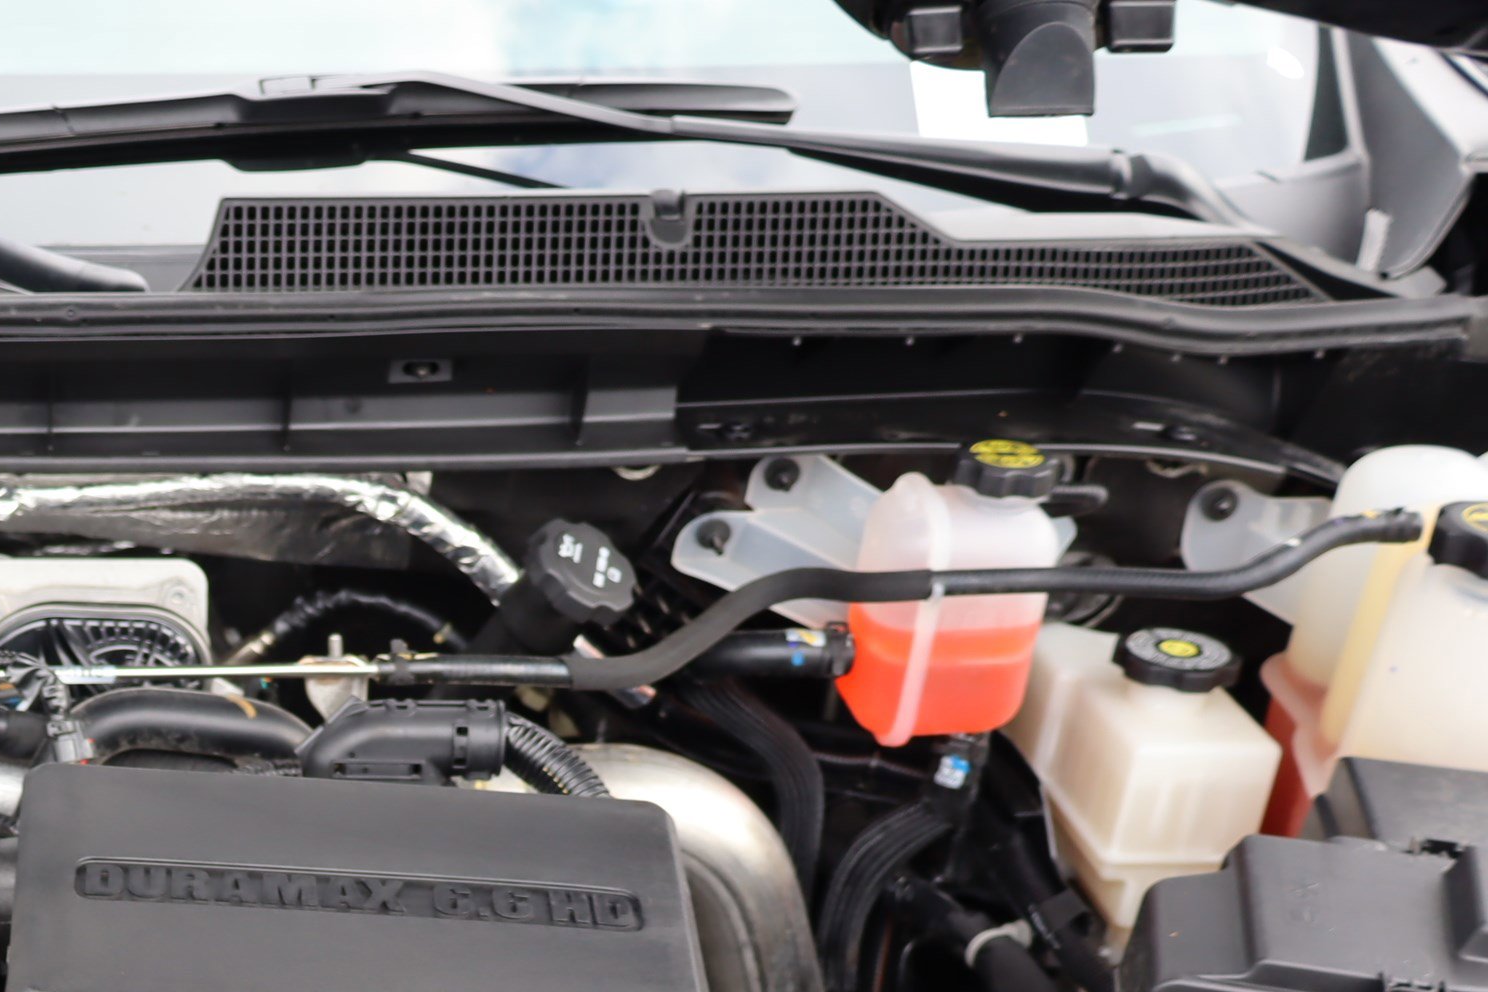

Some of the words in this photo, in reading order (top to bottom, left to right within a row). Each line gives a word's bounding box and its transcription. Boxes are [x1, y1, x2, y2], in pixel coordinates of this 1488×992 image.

[83, 864, 405, 913] DURAMAX
[432, 886, 532, 920] 6.6
[550, 890, 639, 927] HD
